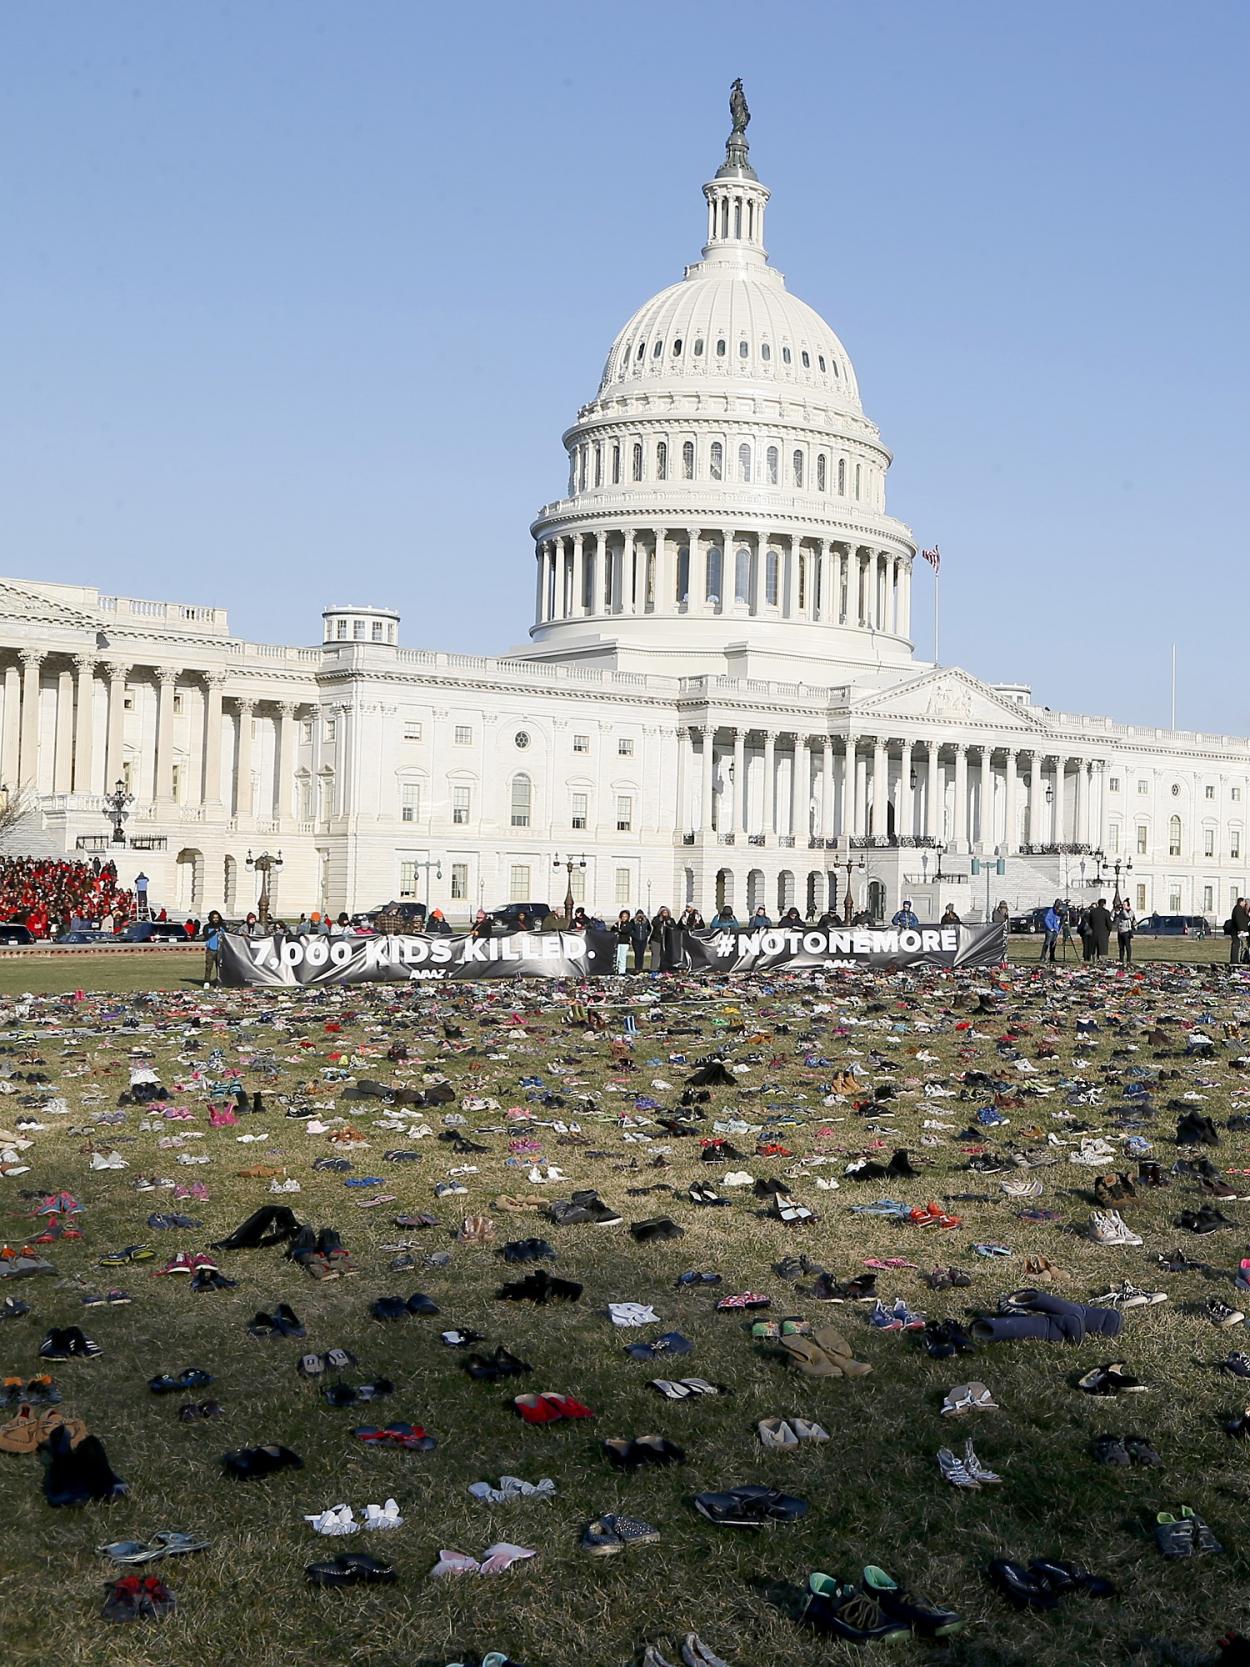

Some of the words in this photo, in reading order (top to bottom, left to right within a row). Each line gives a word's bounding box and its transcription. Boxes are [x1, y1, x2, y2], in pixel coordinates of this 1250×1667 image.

[249, 940, 353, 970] 7,000
[365, 938, 453, 967] KIDS
[456, 936, 596, 964] KILLED.
[716, 929, 957, 957] #NOTONEMORE
[409, 968, 447, 980] AVAAZ
[822, 959, 857, 969] AVAAZ
